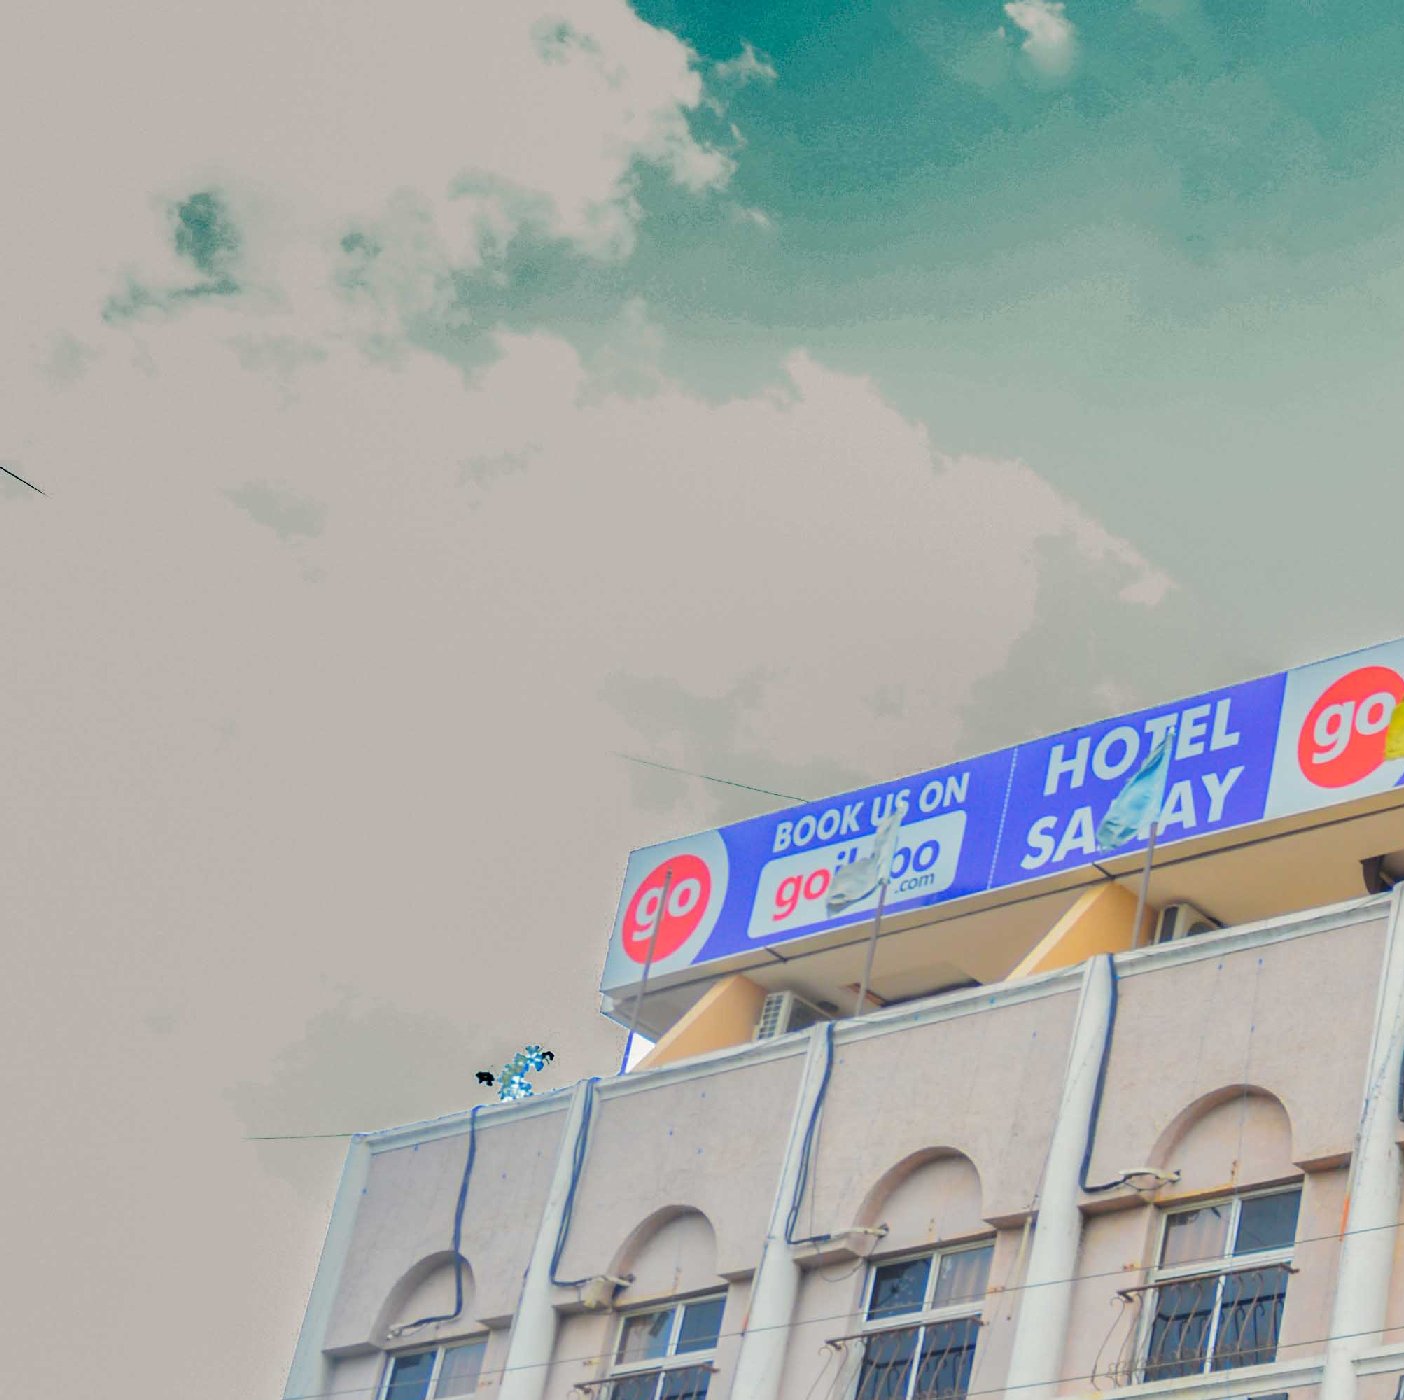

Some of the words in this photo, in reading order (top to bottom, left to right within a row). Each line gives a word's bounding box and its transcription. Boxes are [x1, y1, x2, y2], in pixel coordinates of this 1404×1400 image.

[1044, 697, 1240, 797] HOTEL
[1311, 690, 1395, 764] go
[773, 802, 864, 853] BOOK
[871, 789, 911, 827] US
[919, 772, 970, 812] ON
[1020, 765, 1245, 870] SAAY
[632, 872, 702, 940] go
[894, 872, 935, 894] .com
